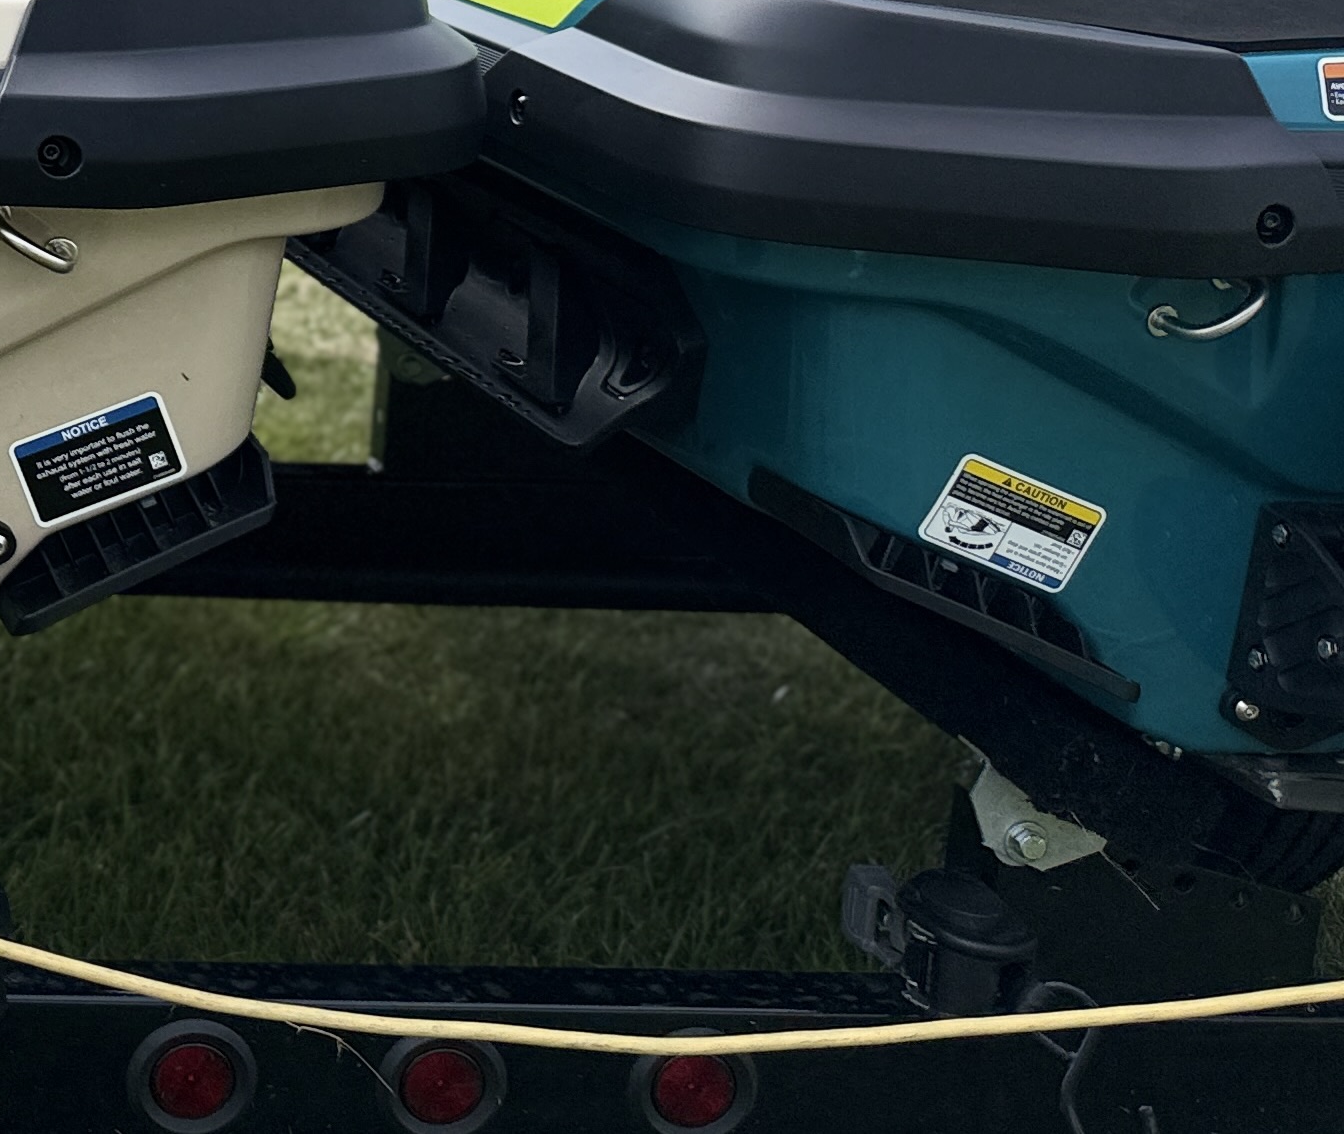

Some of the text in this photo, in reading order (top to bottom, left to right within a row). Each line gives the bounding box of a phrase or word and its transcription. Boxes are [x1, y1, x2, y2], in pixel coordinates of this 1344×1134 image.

[60, 415, 109, 441] NOTICE
[51, 452, 69, 463] very
[68, 437, 107, 457] important
[105, 435, 116, 443] to
[1015, 482, 1068, 510] CAUTION
[1006, 560, 1045, 582] NOTICE
